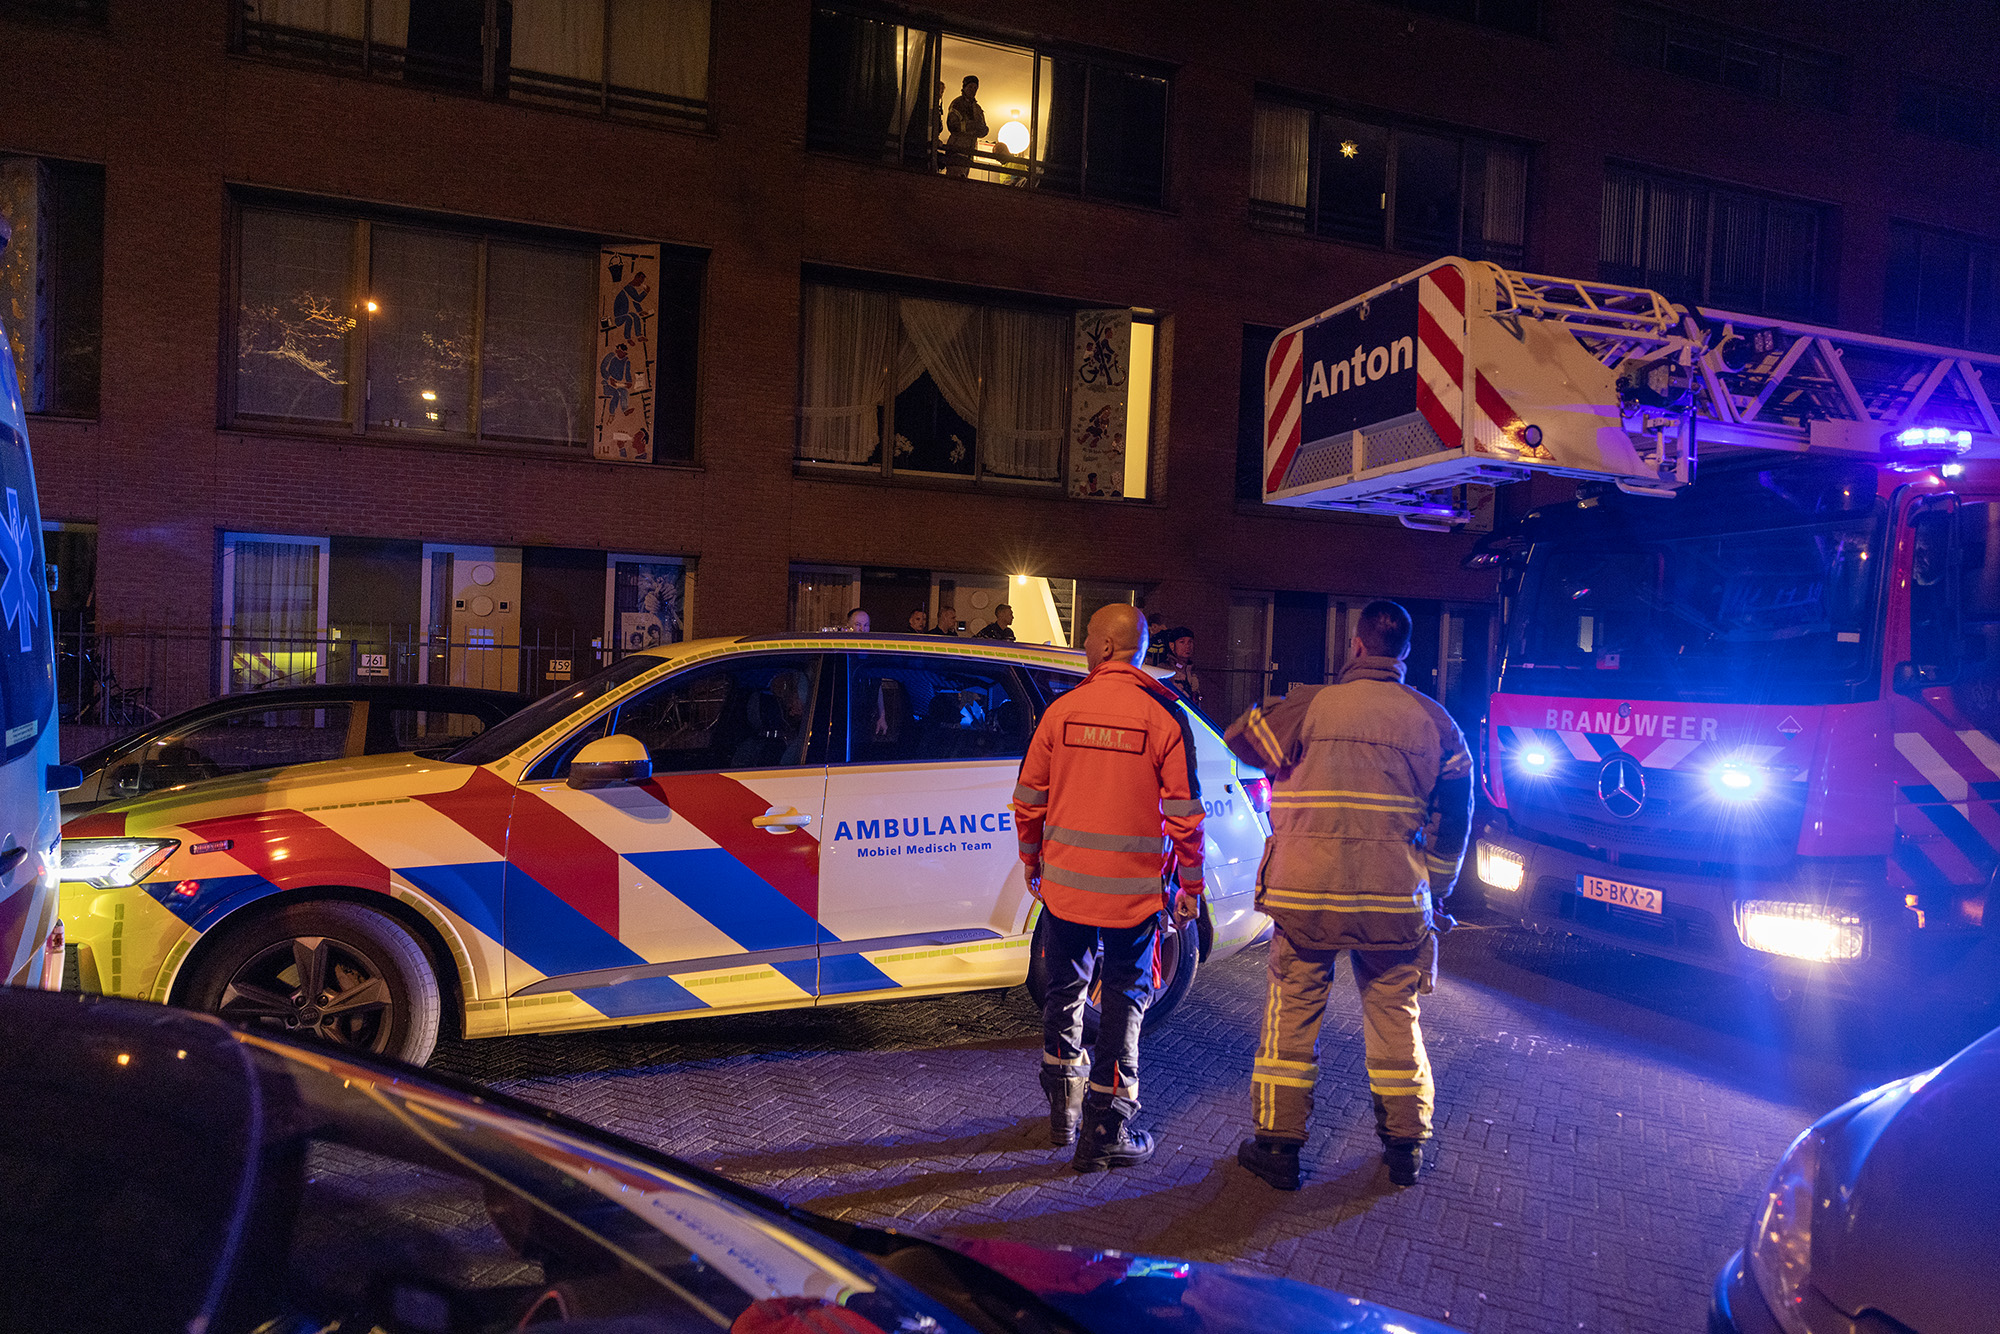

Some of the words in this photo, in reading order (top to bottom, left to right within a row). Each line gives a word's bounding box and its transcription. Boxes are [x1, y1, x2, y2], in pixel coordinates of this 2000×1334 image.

[1305, 335, 1413, 404] Anton
[365, 655, 382, 665] 761
[552, 661, 570, 670] 759
[1545, 708, 1719, 742] BRANDWEER
[1205, 799, 1233, 818] 901
[834, 812, 1012, 841] AMBULANCE
[857, 846, 901, 857] Mobiel
[906, 842, 957, 855] Medisch
[961, 842, 992, 851] Team
[1589, 879, 1655, 909] 15-BKX-2
